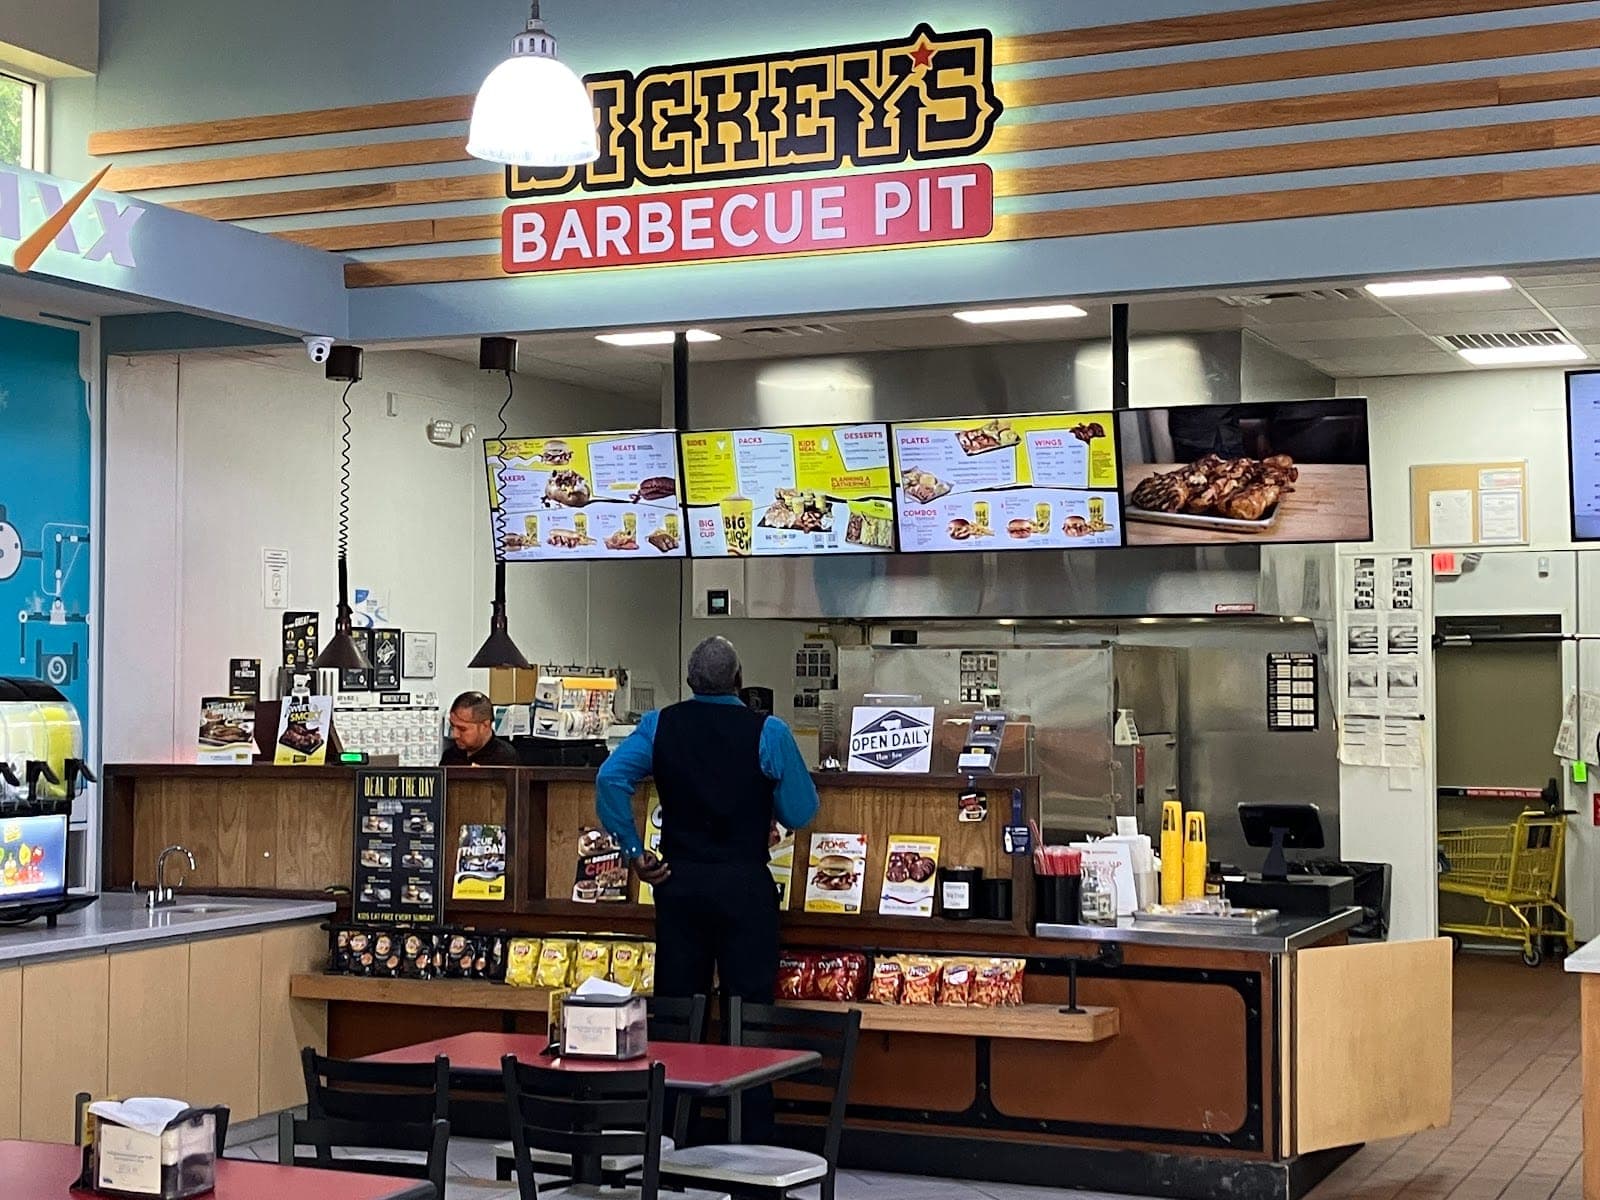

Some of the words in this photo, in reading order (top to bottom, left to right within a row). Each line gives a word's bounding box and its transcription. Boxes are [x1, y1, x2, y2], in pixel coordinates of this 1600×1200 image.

[509, 30, 994, 195] ICKEY'S
[511, 184, 847, 263] BARBECUE
[872, 173, 978, 236] PIT
[844, 431, 883, 440] DESSERTS
[900, 437, 930, 445] PLATES
[903, 509, 938, 517] COMBOS
[698, 519, 715, 528] BIG
[700, 531, 716, 539] CUP
[852, 737, 888, 752] OPEN
[892, 728, 932, 747] DAILY
[363, 775, 386, 798] DEAL
[388, 776, 399, 798] OF
[401, 776, 417, 798] THE
[418, 776, 437, 798] DAY
[816, 840, 849, 850] ATOMIC
